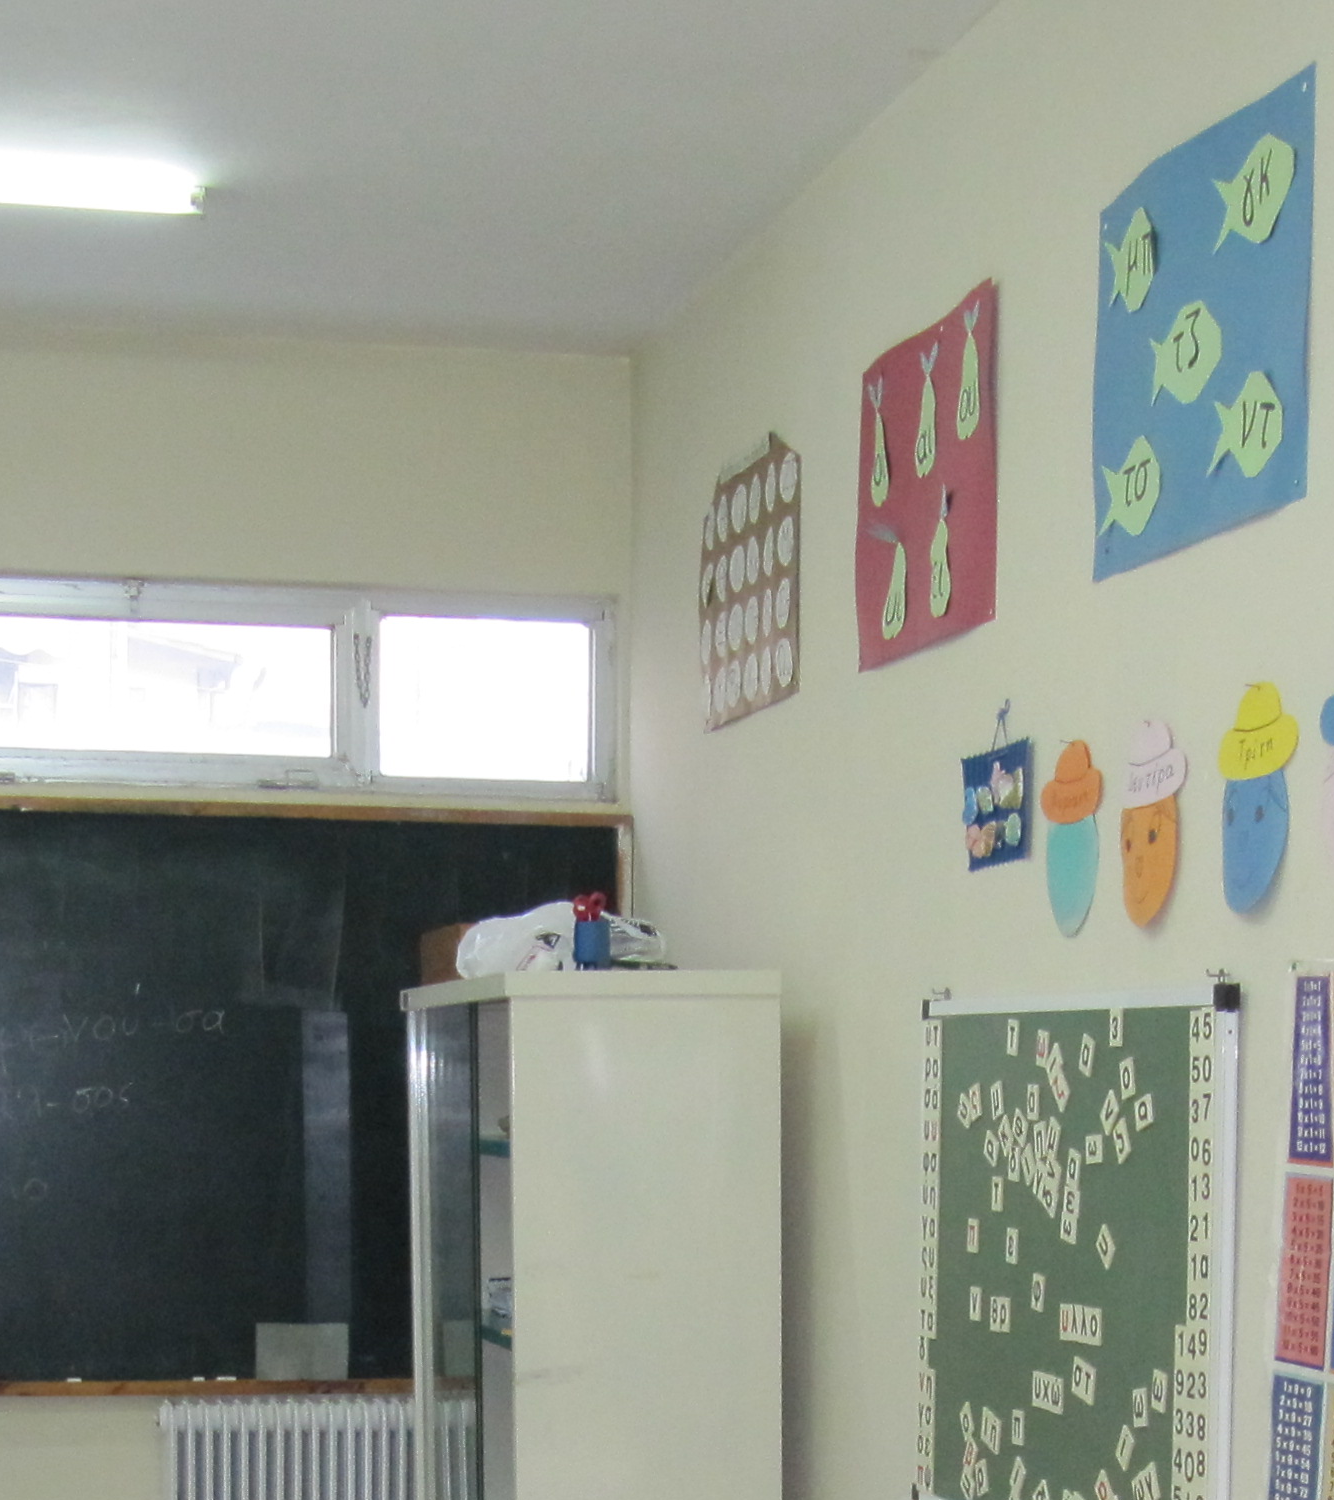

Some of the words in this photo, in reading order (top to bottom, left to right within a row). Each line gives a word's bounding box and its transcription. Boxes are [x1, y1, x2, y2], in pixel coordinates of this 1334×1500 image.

[1191, 1012, 1213, 1043] 45
[1190, 1054, 1213, 1084] 50
[1191, 1093, 1212, 1124] 37
[1190, 1172, 1211, 1202] 13
[1189, 1211, 1210, 1243] 21
[1188, 1293, 1209, 1321] 82
[1177, 1328, 1208, 1361] 149
[1175, 1368, 1207, 1400] 923
[1174, 1407, 1206, 1441] 338
[1173, 1447, 1206, 1483] 408
